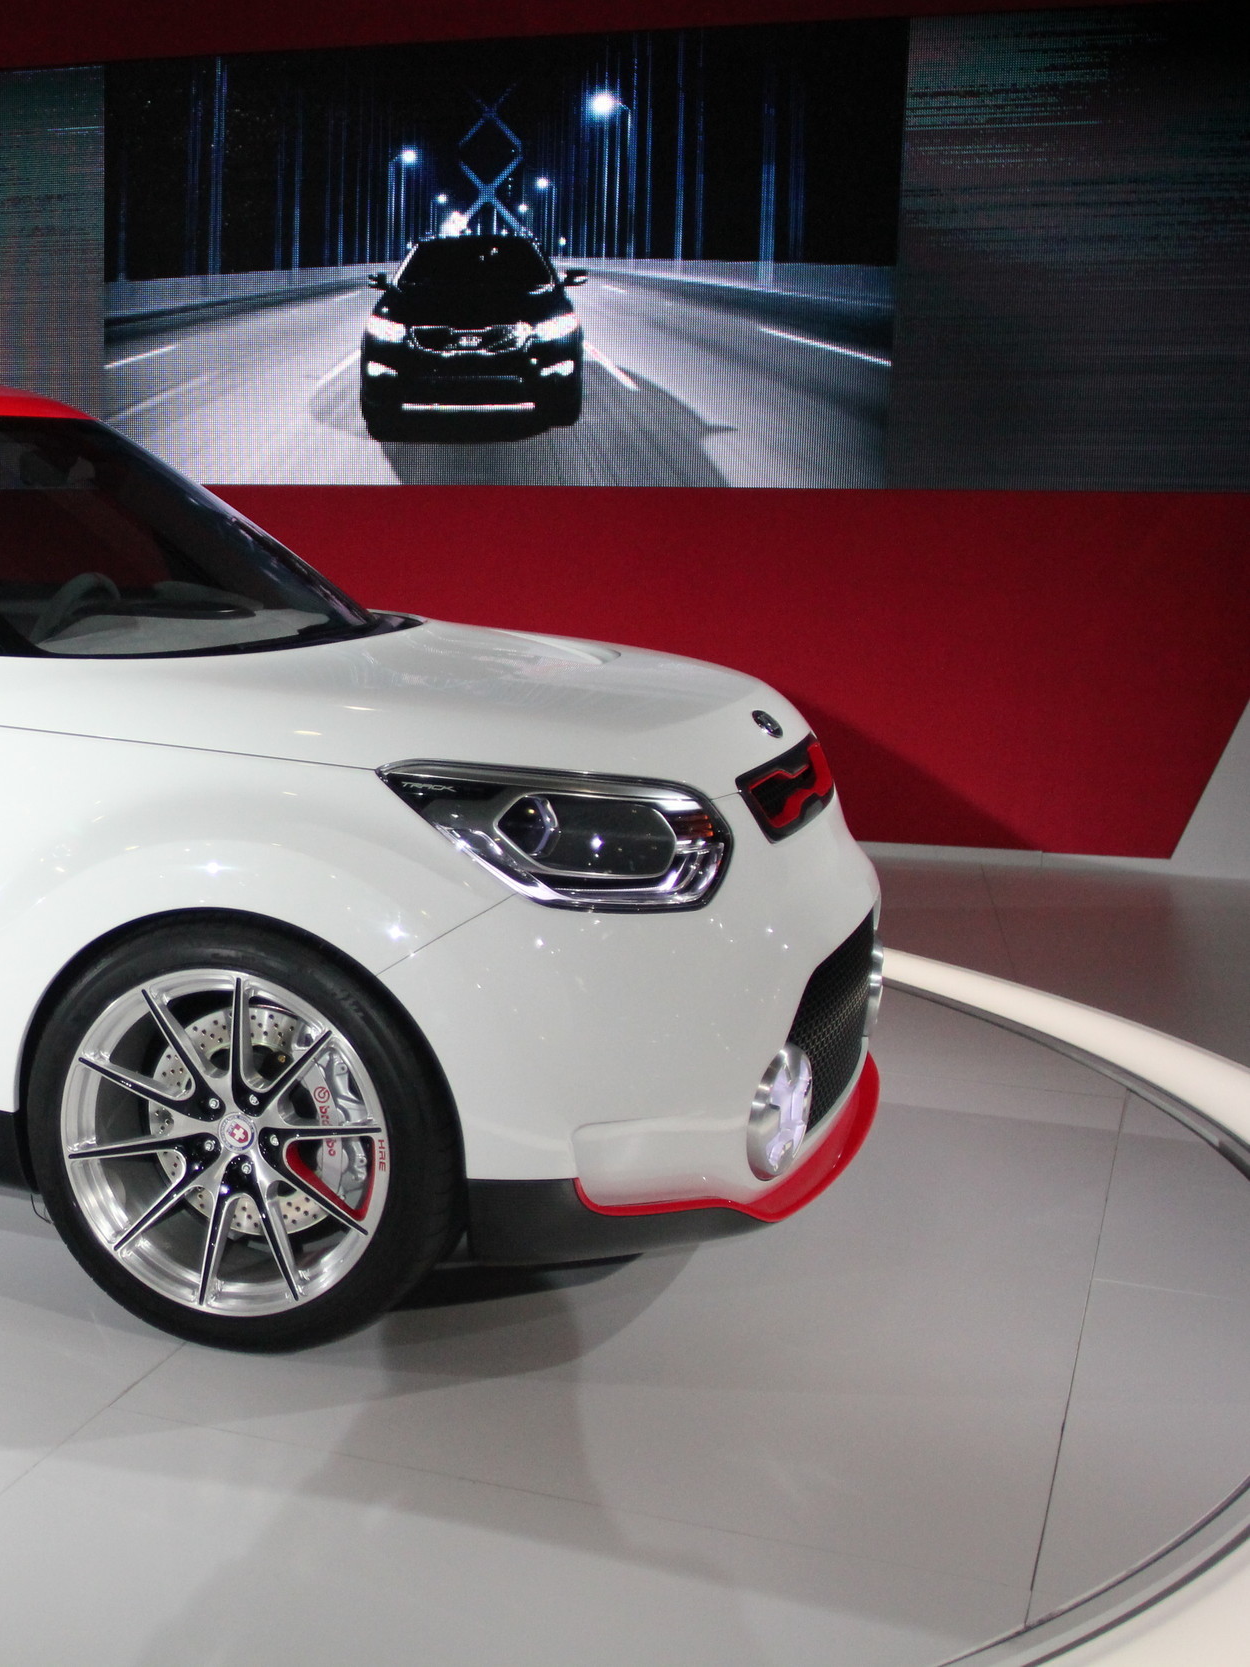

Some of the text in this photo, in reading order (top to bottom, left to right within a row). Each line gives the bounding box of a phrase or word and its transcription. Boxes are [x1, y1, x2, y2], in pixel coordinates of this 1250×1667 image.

[401, 781, 457, 793] TRACK
[319, 1105, 337, 1157] brebo
[378, 1139, 387, 1172] HRE
